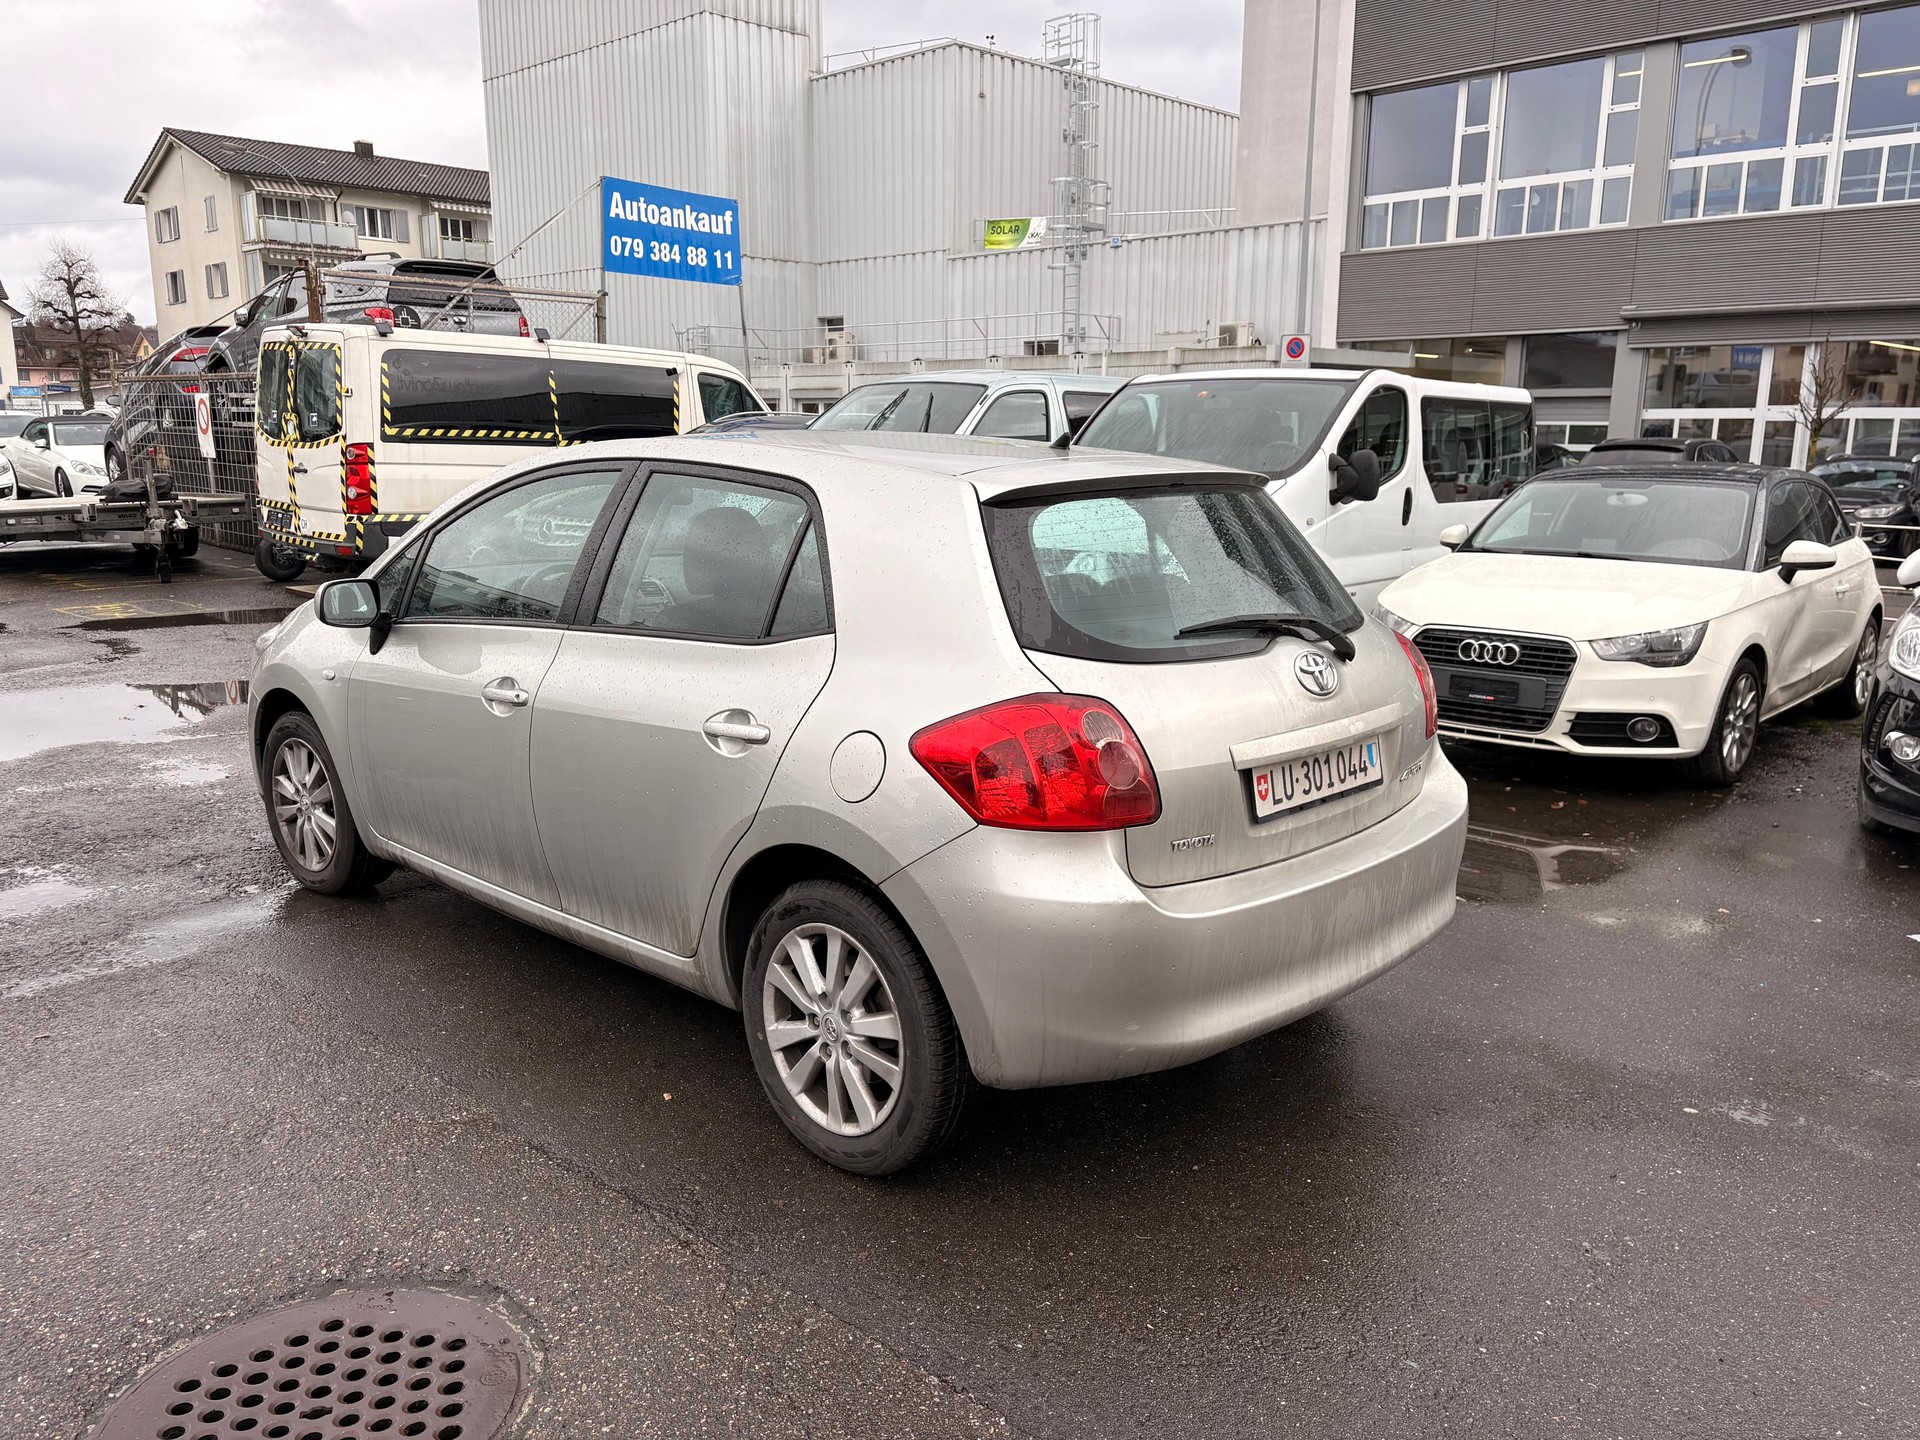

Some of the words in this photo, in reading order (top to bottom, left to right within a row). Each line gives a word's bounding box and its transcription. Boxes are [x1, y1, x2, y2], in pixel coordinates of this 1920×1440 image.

[609, 191, 733, 235] Autoankauf
[990, 225, 1020, 235] SOLAR
[610, 235, 644, 259] 079
[649, 241, 681, 264] 384
[686, 246, 707, 267] 88
[713, 249, 733, 270] 11
[301, 518, 308, 530] CH
[1171, 833, 1215, 852] TOYOTA
